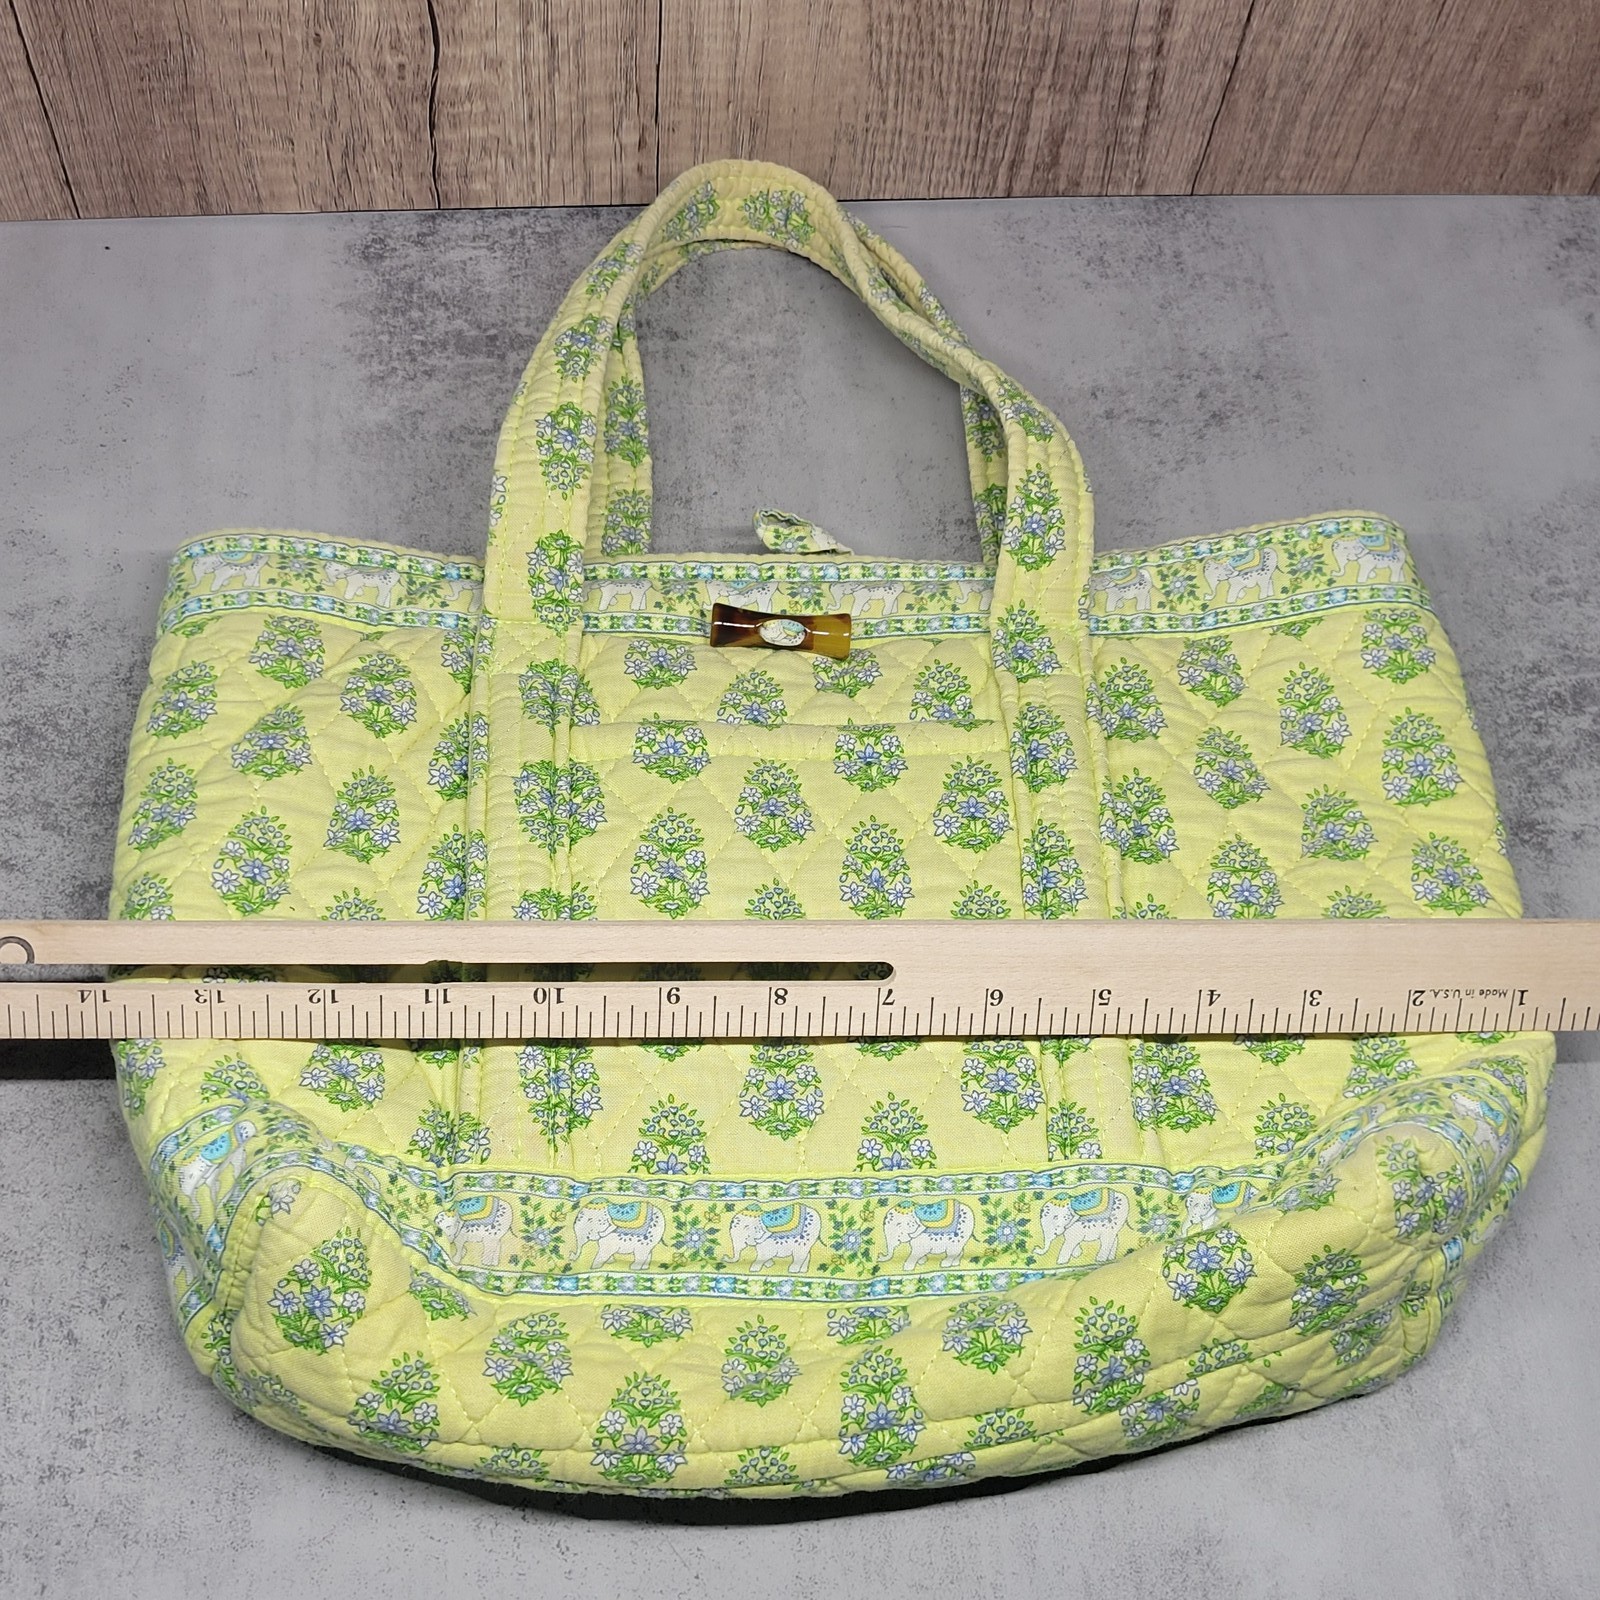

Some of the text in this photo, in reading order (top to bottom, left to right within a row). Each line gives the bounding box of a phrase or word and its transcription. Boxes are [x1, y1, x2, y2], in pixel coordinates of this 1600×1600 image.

[77, 989, 110, 1003] 14
[195, 988, 225, 1004] 13
[308, 988, 338, 1004] 12
[425, 988, 451, 1004] 11
[533, 987, 565, 1005] 10
[666, 987, 681, 1005] 9
[774, 988, 788, 1005] 8
[882, 988, 896, 1006] 7
[989, 988, 1004, 1006] 6
[1098, 989, 1112, 1007] 5
[1207, 989, 1221, 1006] 4
[1309, 989, 1323, 1007] 3
[1412, 989, 1426, 1007] 2
[1430, 988, 1508, 999] Made in U.S.A.
[1517, 989, 1529, 1006] 1
